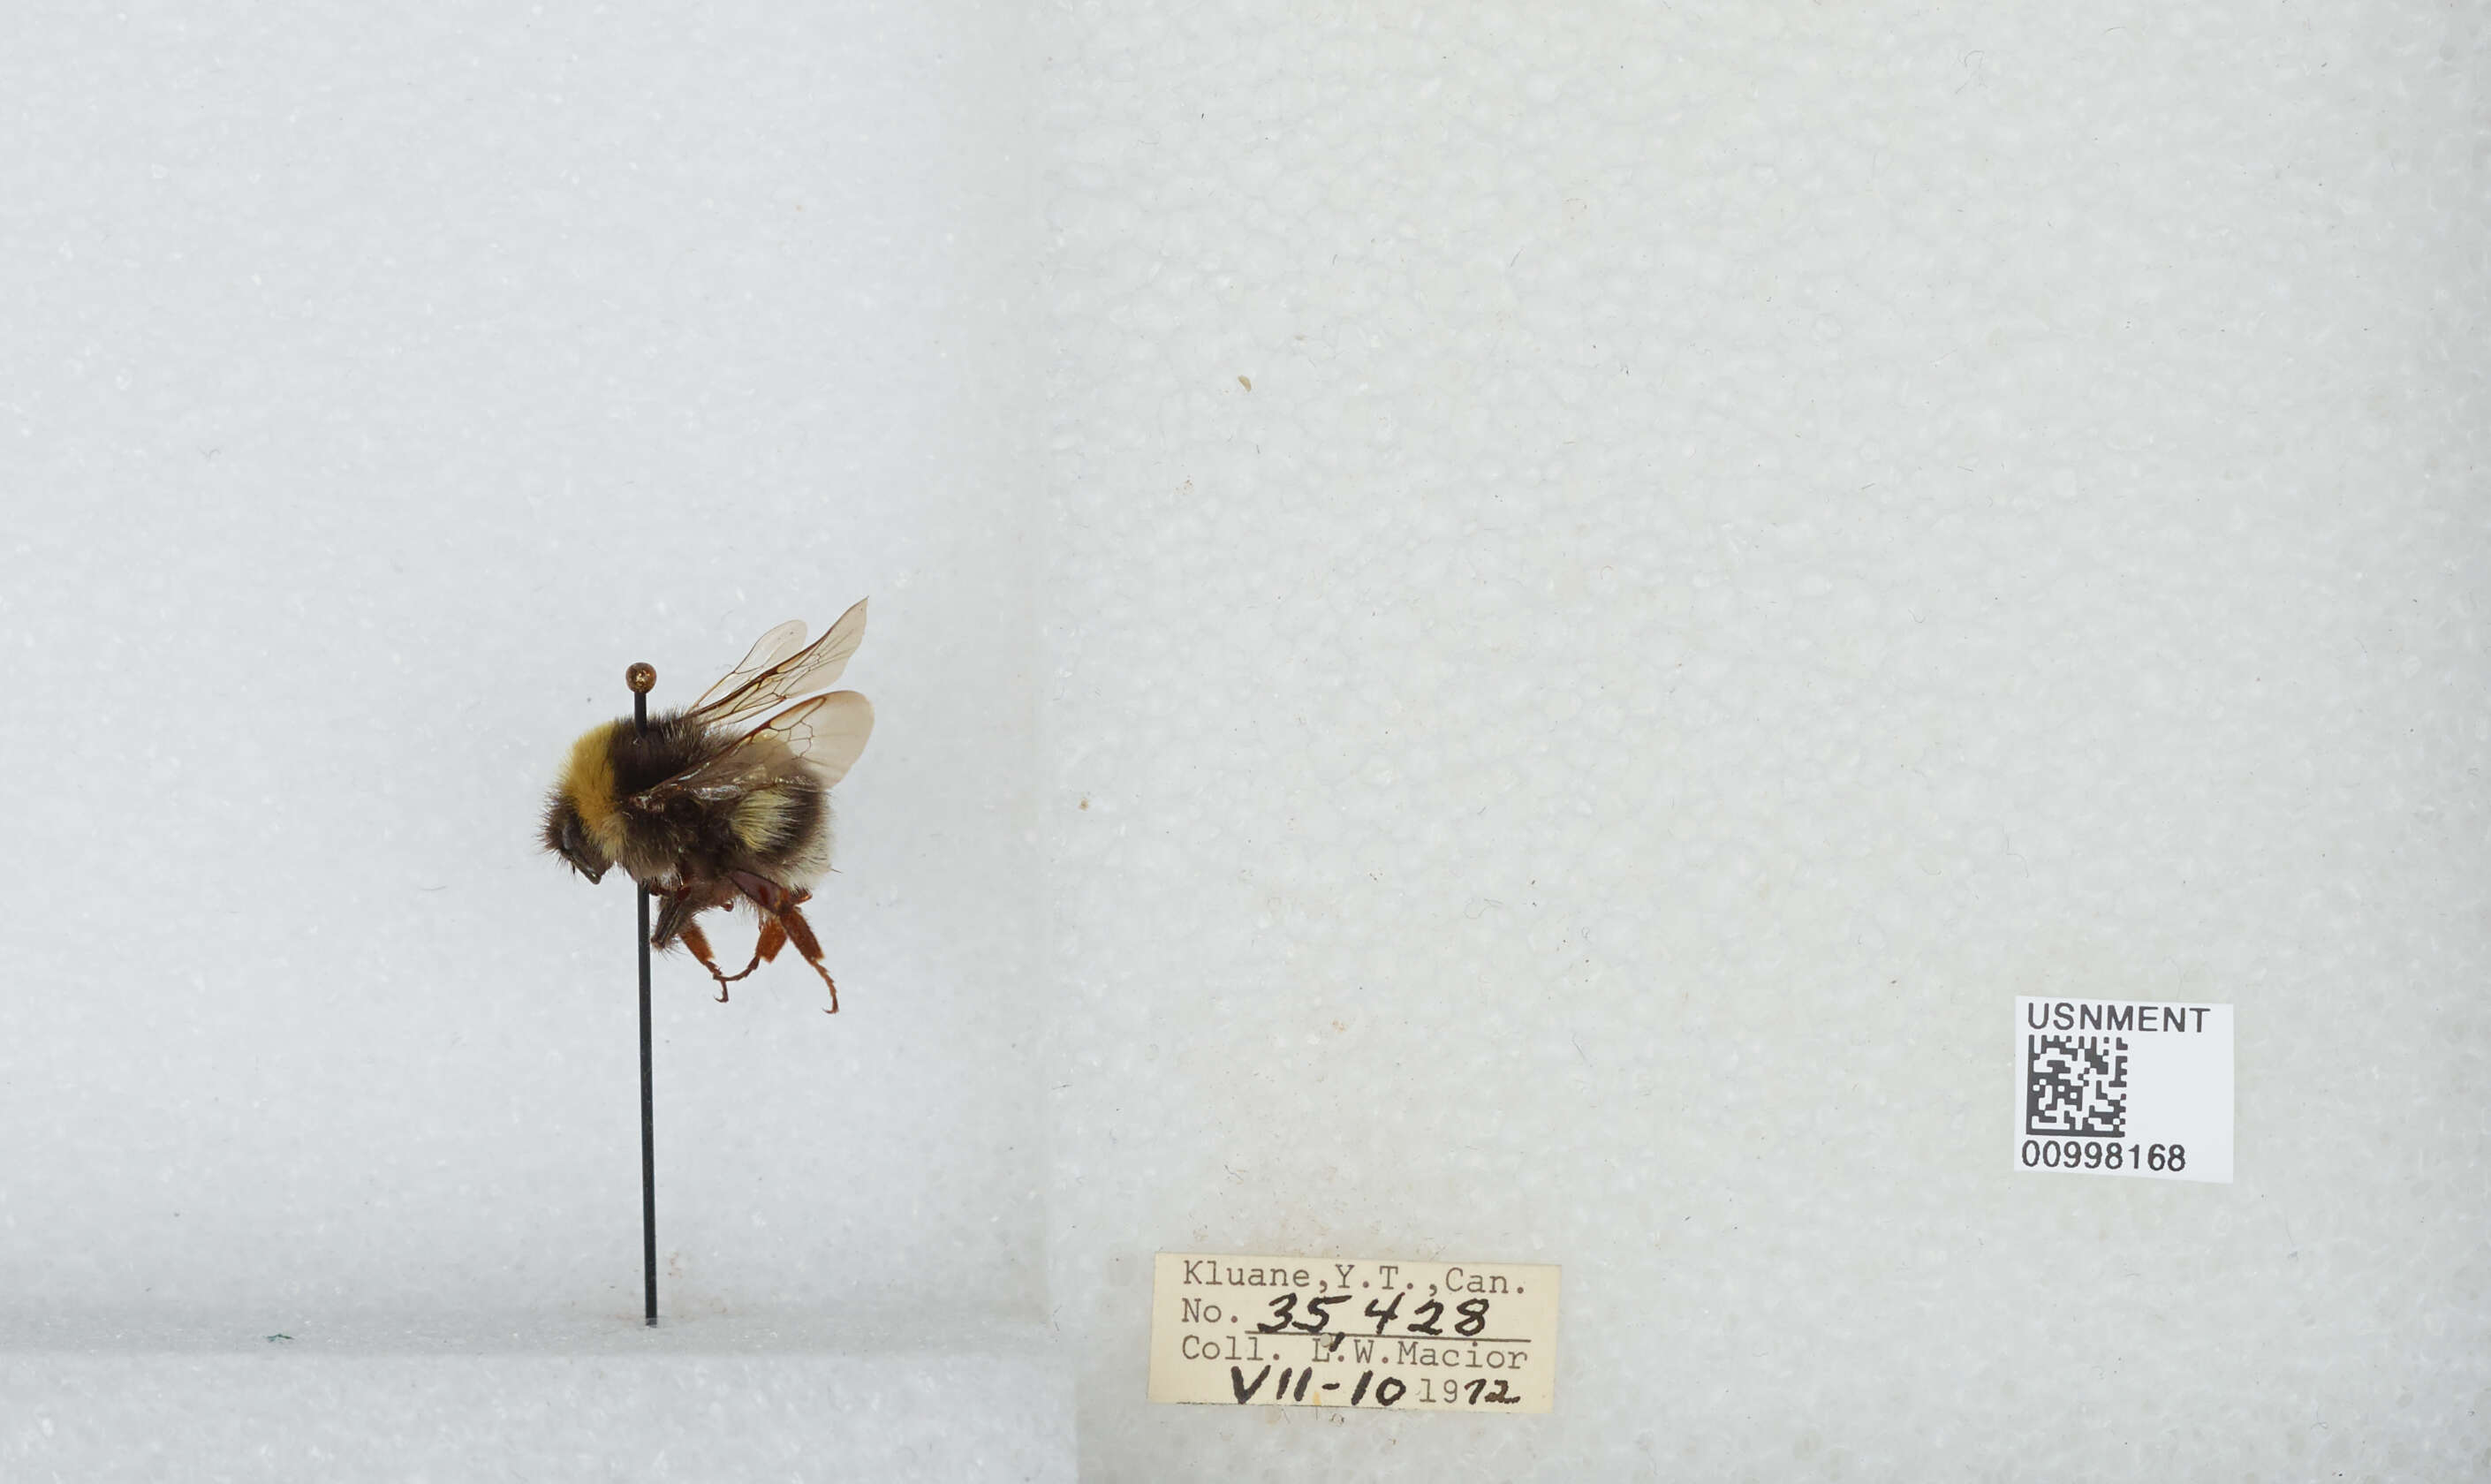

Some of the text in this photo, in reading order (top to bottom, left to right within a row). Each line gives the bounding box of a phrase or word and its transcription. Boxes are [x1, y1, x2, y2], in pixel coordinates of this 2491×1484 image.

[2028, 1002, 2211, 1033] USNMENT
[2022, 1140, 2186, 1172] 00998168
[1182, 1298, 1238, 1323] No.
[1182, 1336, 1281, 1361] Coll.
[1231, 1365, 1521, 1406] VII-10 1972
